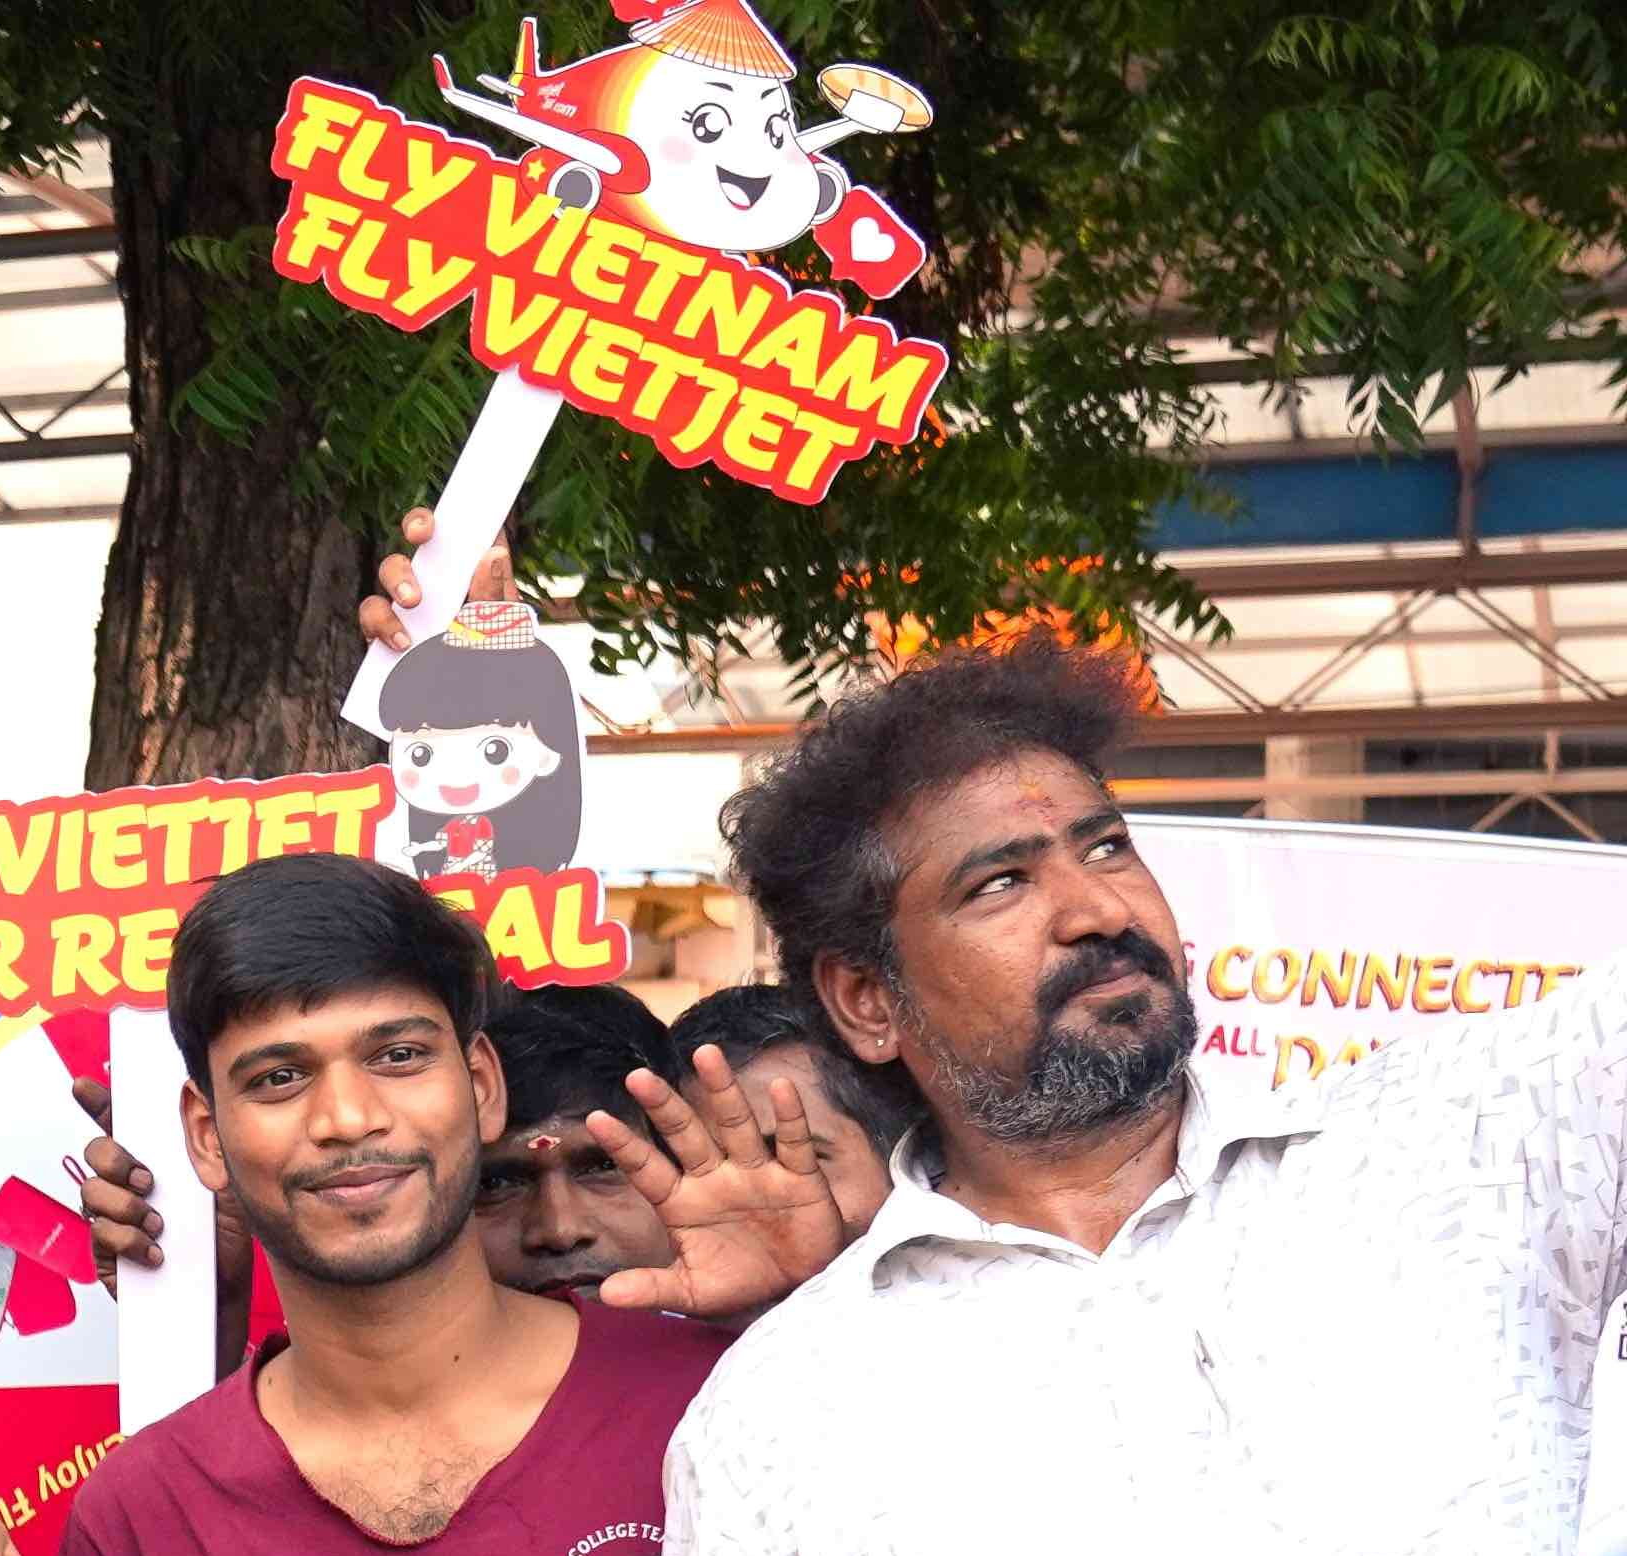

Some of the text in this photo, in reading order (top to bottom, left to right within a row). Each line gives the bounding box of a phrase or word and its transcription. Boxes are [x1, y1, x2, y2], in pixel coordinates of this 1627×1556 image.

[287, 93, 931, 429] FLY VIETNAM
[287, 193, 860, 491] FLY VIETJET
[1203, 1024, 1267, 1058] ALL
